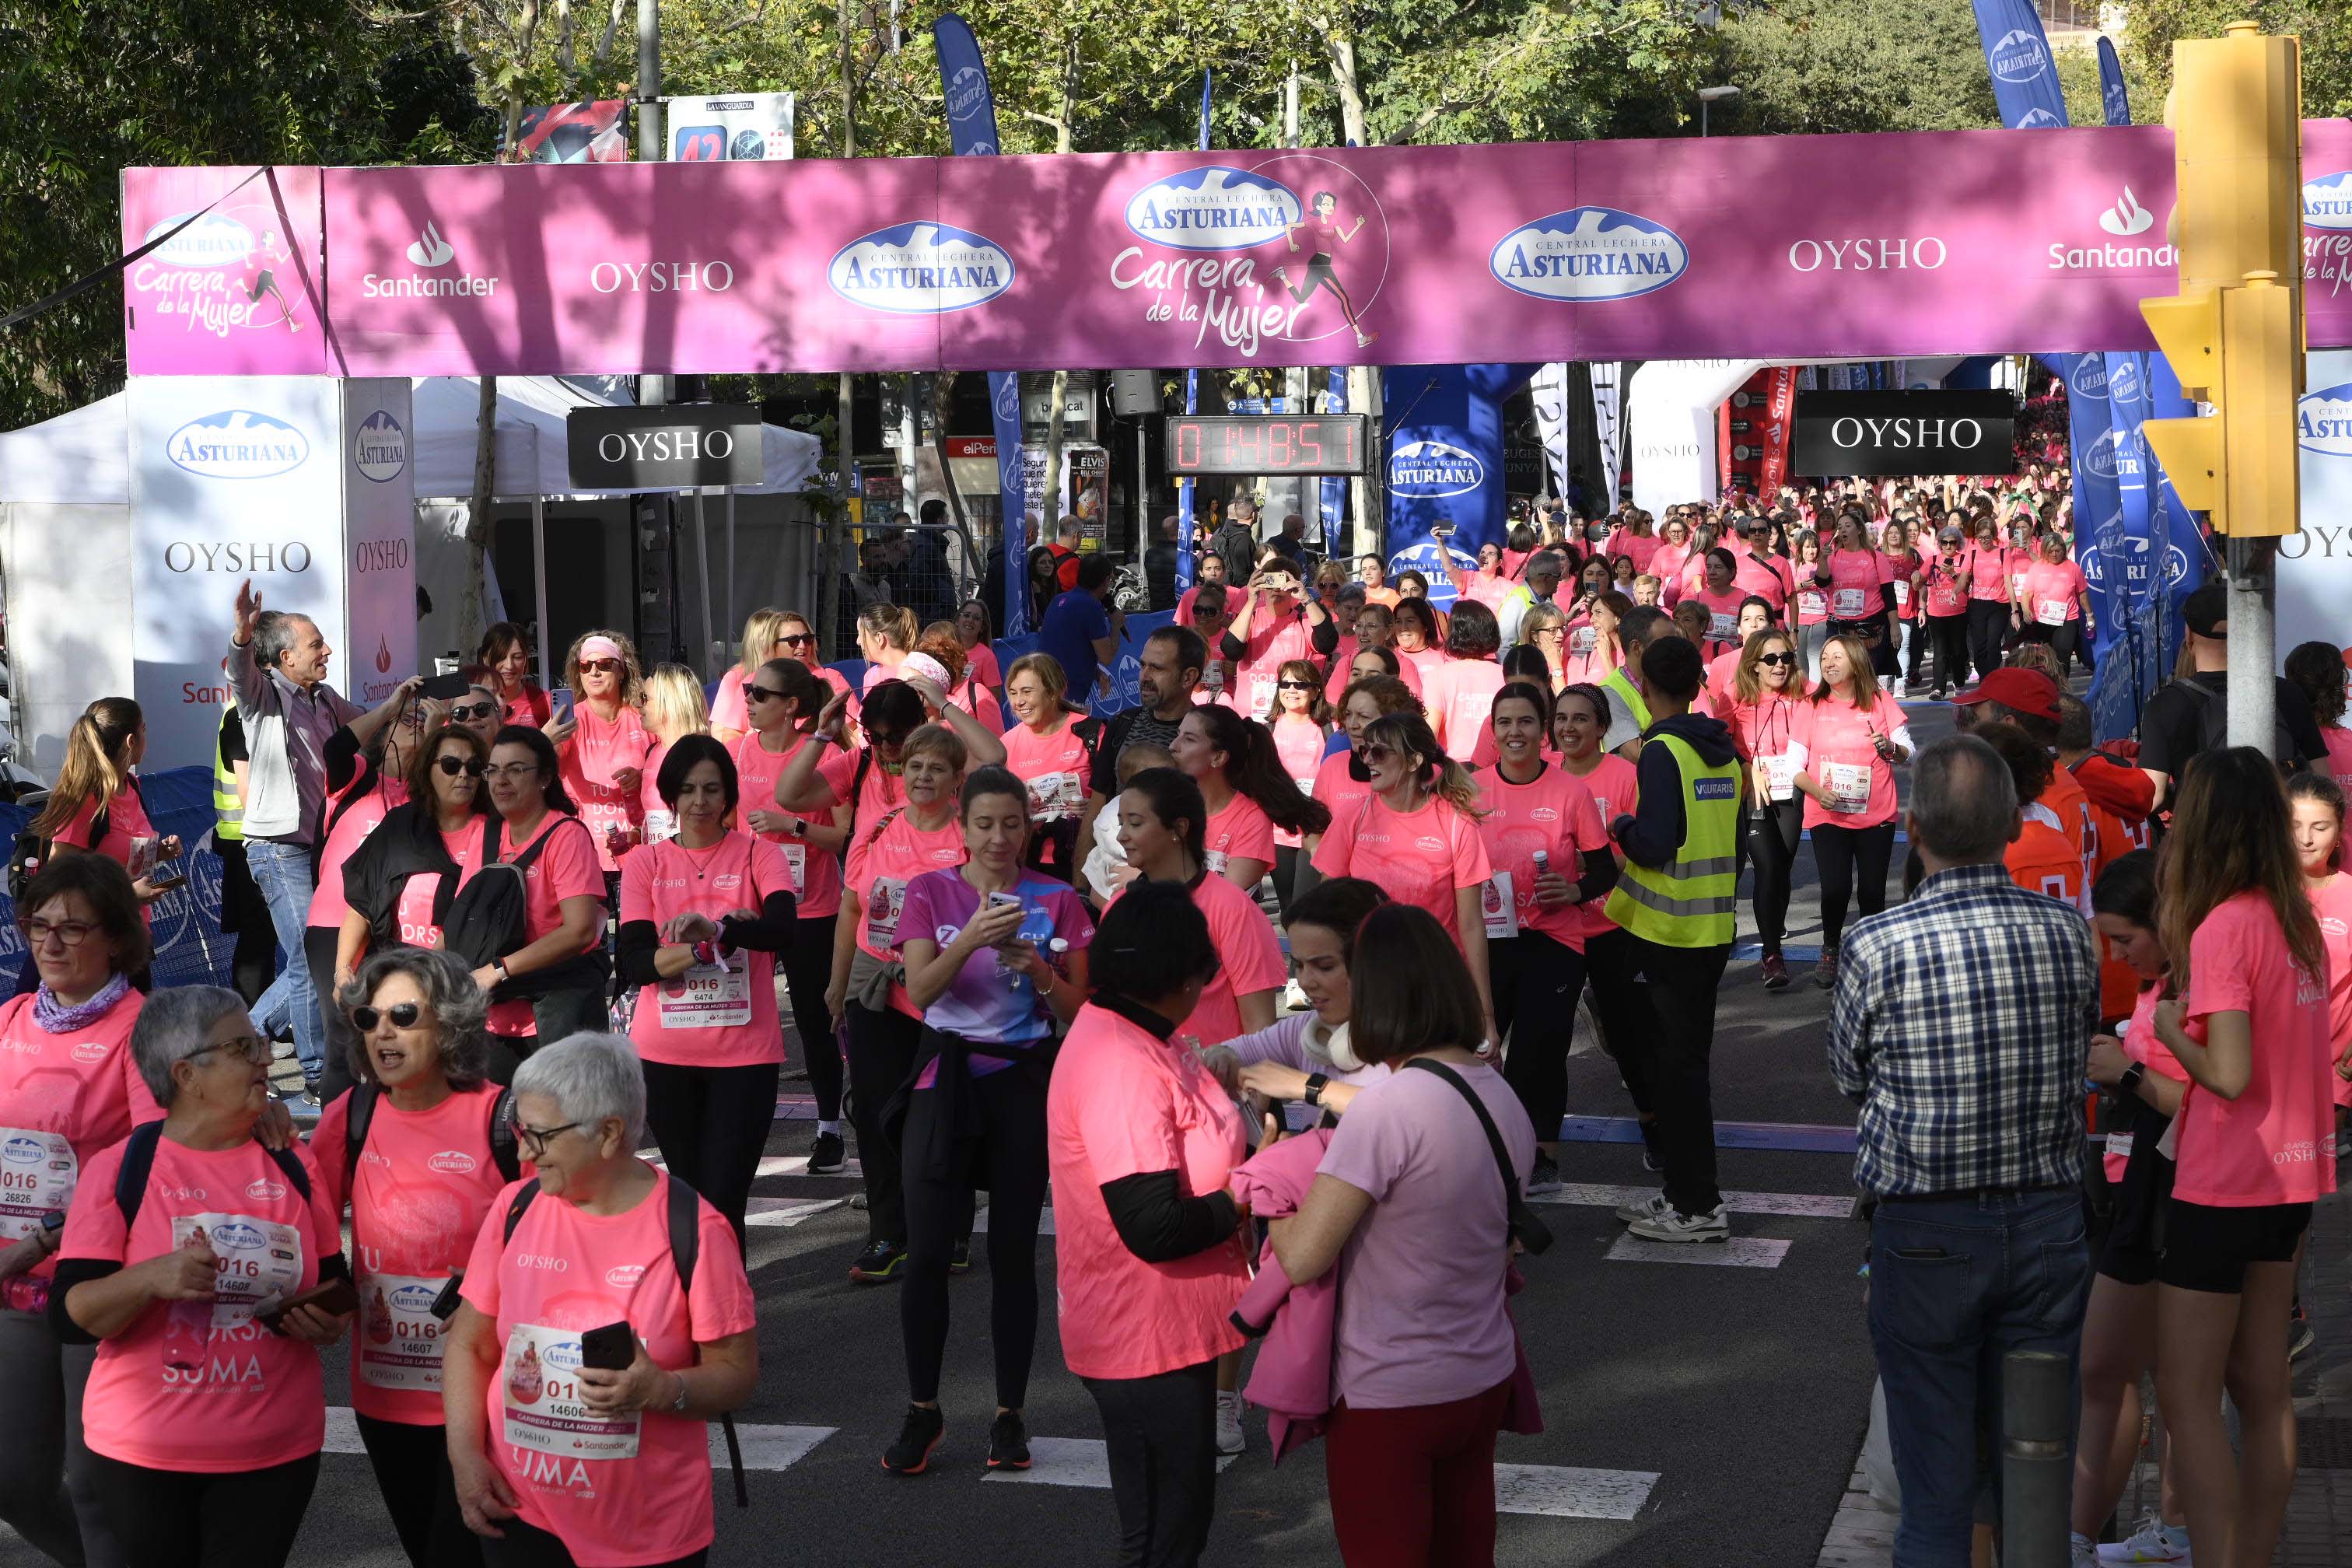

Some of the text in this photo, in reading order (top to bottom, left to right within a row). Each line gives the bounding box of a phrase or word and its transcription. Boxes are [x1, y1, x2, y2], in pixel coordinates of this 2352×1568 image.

[715, 102, 754, 110] VANGUARDIA
[1227, 194, 1283, 202] LECHERA
[1139, 199, 1287, 229] ASTURIANA
[1536, 239, 1666, 250] CENTRAL LECHERA
[1505, 243, 1672, 278] ASTURIANA
[1789, 237, 1947, 271] OYSHO
[843, 257, 1000, 289] ASTURIANA
[1110, 247, 1256, 289] Carrera
[2321, 258, 2335, 279] la
[135, 263, 226, 292] Carrera
[591, 261, 733, 293] OYSHO
[363, 274, 499, 298] Santander
[157, 292, 261, 337] de la Mujer
[1146, 285, 1311, 357] de la Mujer
[1041, 401, 1083, 412] b.cat
[1832, 418, 1982, 449] OYSHO
[178, 436, 298, 462] ASTURIANA
[358, 436, 404, 464] ASTURIANA
[598, 430, 733, 463] OYSHO
[1641, 444, 1700, 459] OYSHO
[1081, 457, 1104, 467] ELVIS
[1388, 466, 1476, 485] ASTURIANA
[1762, 447, 1781, 499] Sports
[1024, 481, 1048, 491] quiere
[165, 541, 311, 572] OYSHO
[356, 537, 407, 572] OYSHO
[1019, 758, 1042, 768] OYSHO
[591, 785, 610, 798] TU
[1834, 782, 1852, 791] 016
[1336, 791, 1363, 800] OYSHO
[1358, 833, 1390, 843] OYSHO
[886, 844, 912, 854] OYSHO
[653, 877, 686, 888] OYSHO
[1486, 926, 1508, 935] OYSHO
[688, 978, 719, 992] 016
[694, 993, 713, 1002] 6474
[5, 1146, 41, 1159] ASTURIANA
[4, 1171, 37, 1188] 016
[5, 1192, 31, 1204] 26826
[218, 1230, 263, 1245] ASTURIANA
[219, 1257, 259, 1277] 016
[517, 1252, 568, 1273] OYSHO
[219, 1279, 251, 1292] 14608
[394, 1296, 433, 1307] ASTURIAN
[397, 1321, 437, 1339] 016
[401, 1342, 432, 1355] 14607
[547, 1381, 574, 1400] 01
[517, 1413, 551, 1426] CARRERA
[514, 1426, 626, 1450] OYSHO Santander
